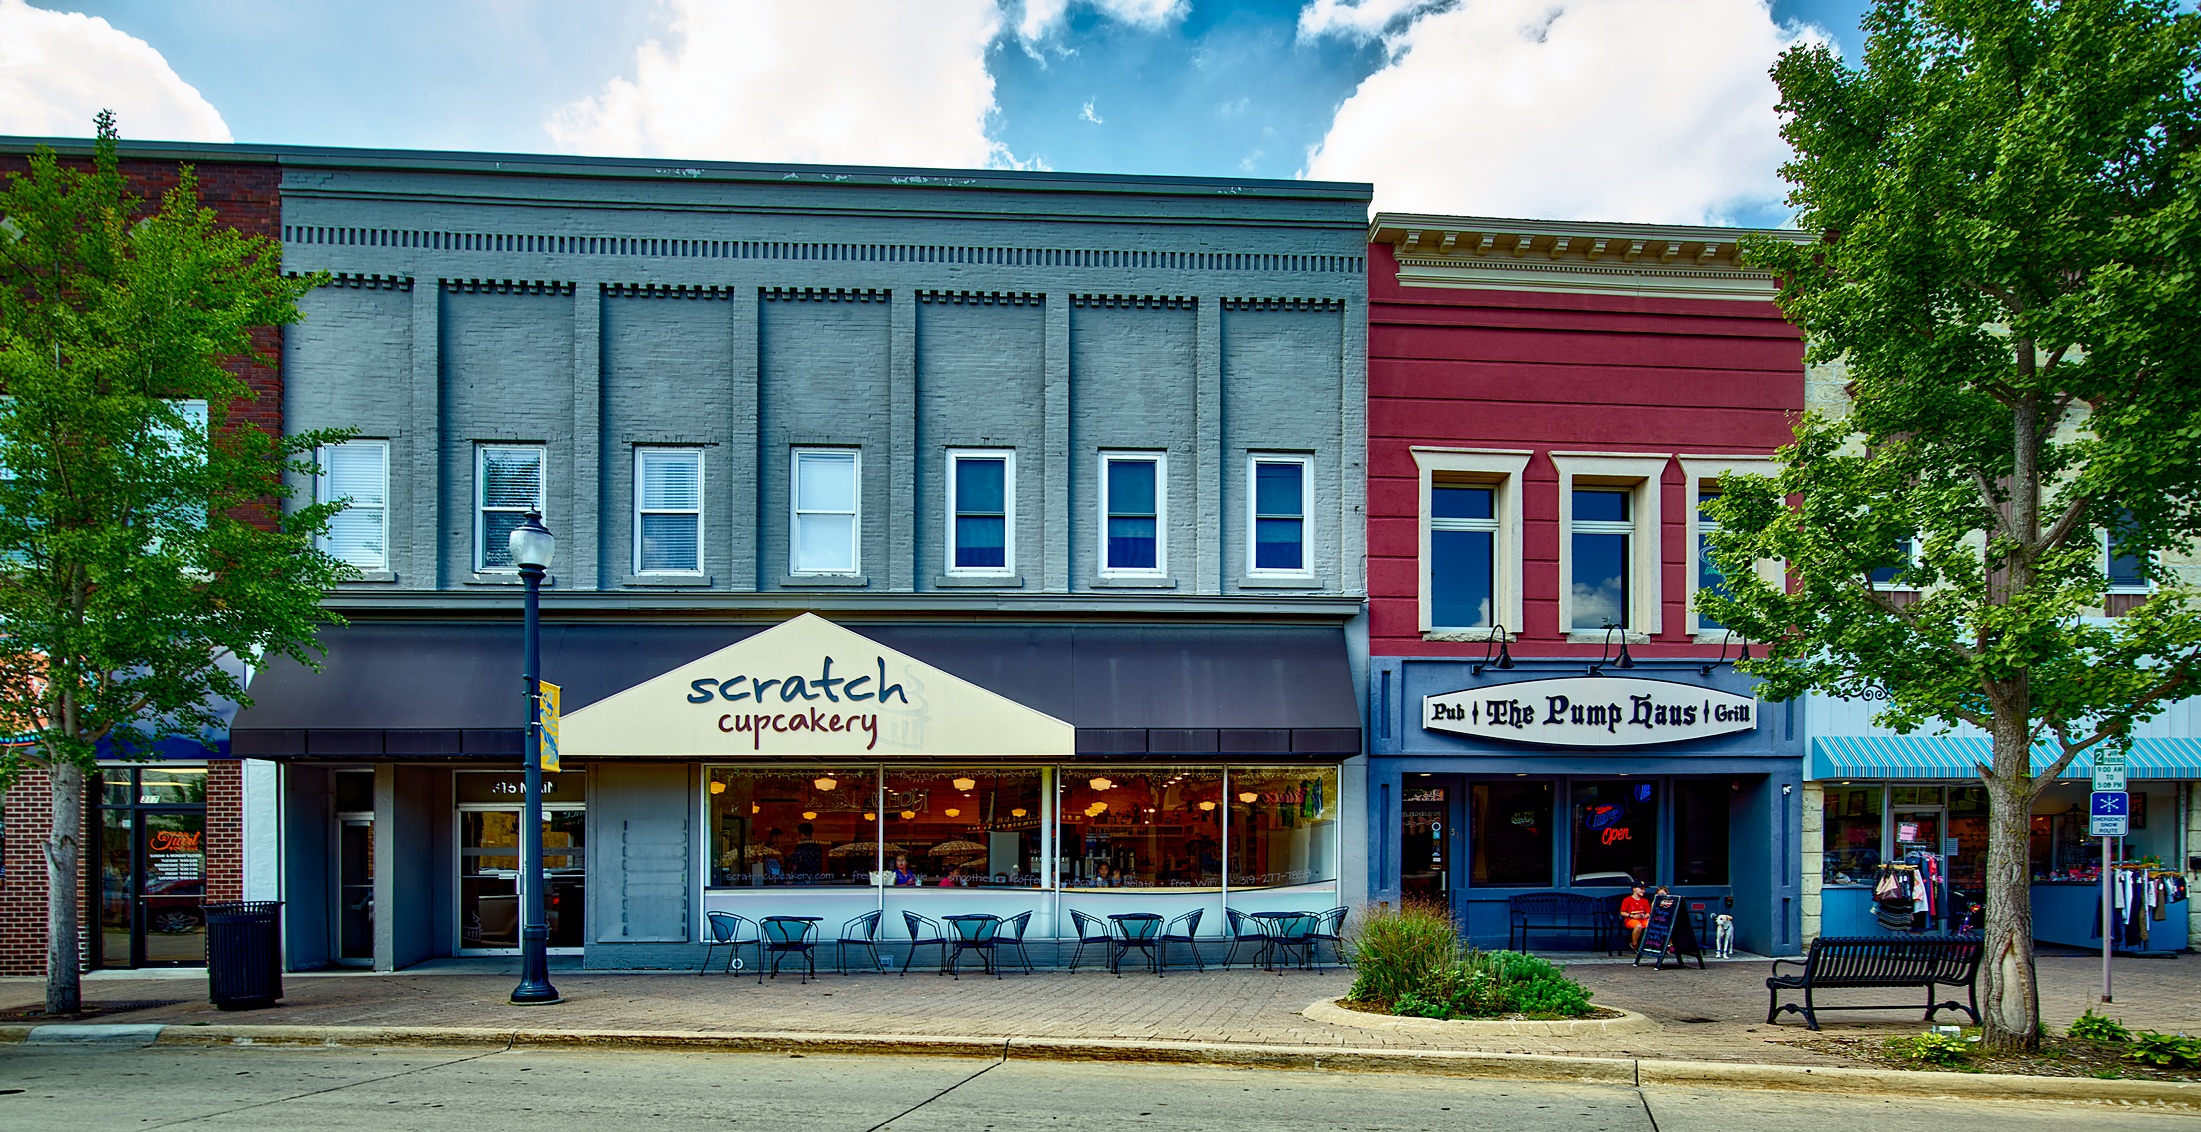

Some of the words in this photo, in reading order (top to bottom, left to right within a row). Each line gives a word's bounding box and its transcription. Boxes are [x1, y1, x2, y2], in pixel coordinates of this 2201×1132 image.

[687, 656, 908, 704] scratch
[718, 706, 877, 750] cupcakery
[1431, 703, 1465, 721] Pub
[1486, 699, 1535, 729] The
[1542, 694, 1623, 734] Pump
[1628, 693, 1698, 729] Haus
[1714, 703, 1751, 722] Grill
[2095, 751, 2102, 762] 2
[1602, 827, 1632, 846] Open
